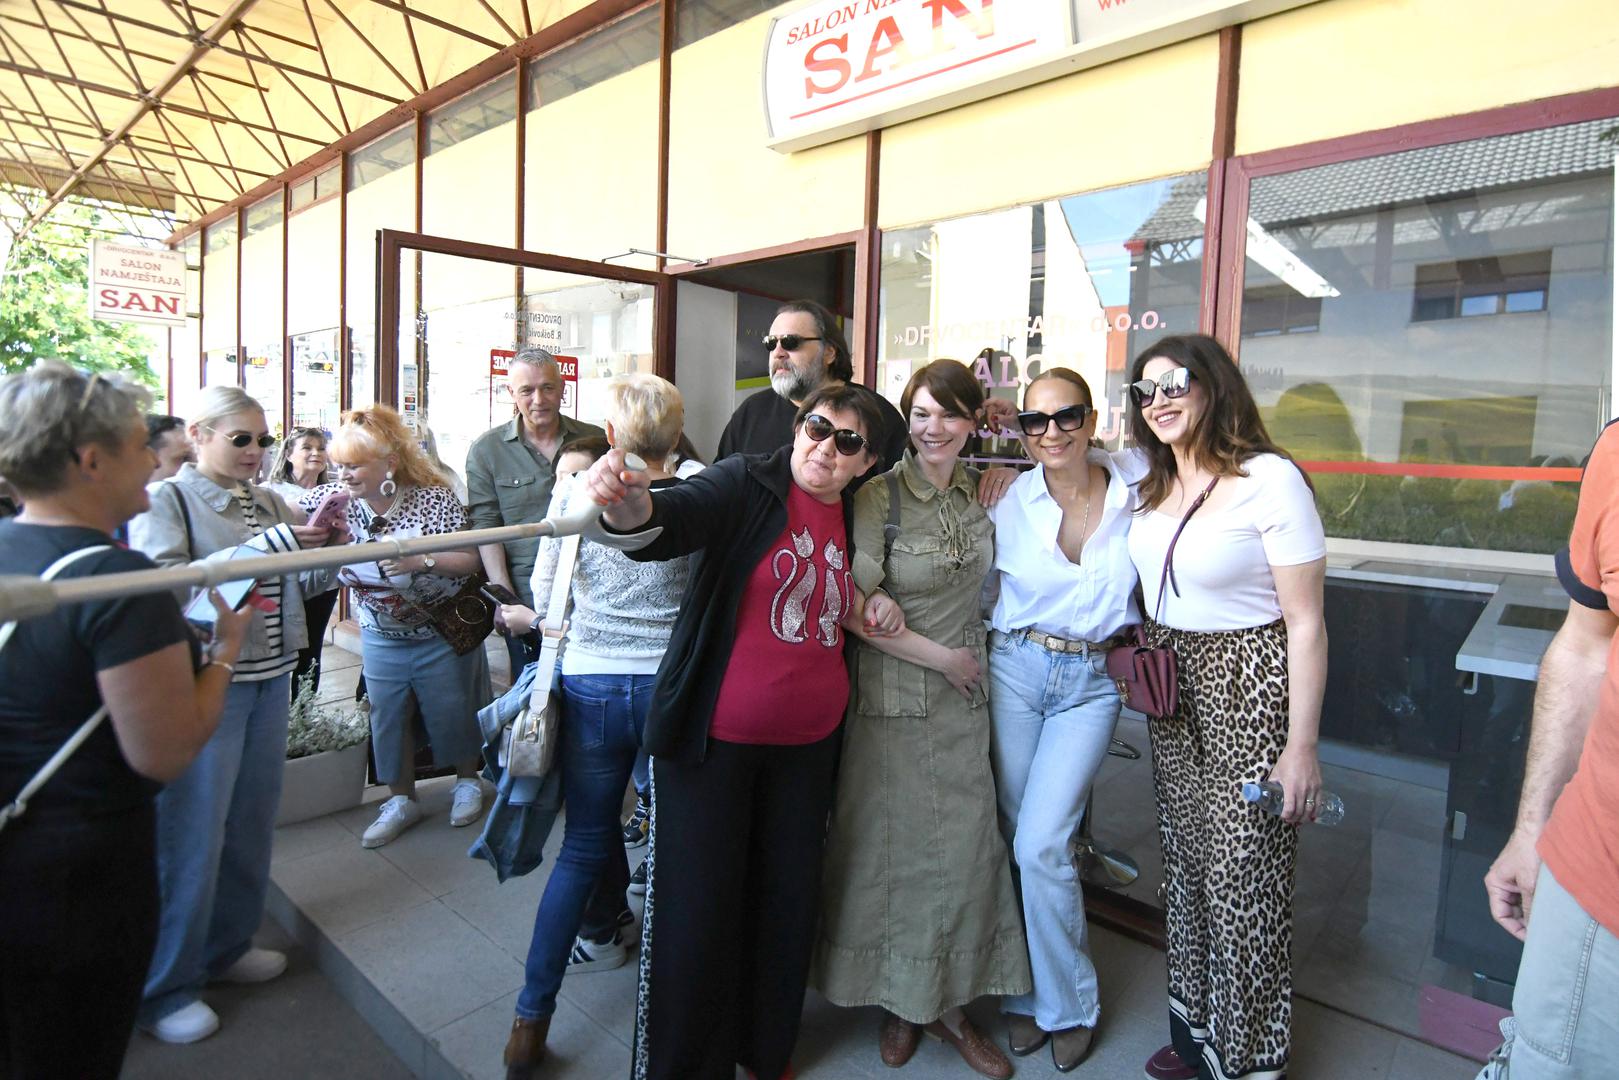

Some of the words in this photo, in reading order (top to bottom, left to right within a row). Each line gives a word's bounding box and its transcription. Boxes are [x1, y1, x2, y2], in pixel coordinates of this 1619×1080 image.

[786, 2, 859, 46] SALON
[803, 0, 996, 100] SAN
[99, 267, 182, 287] NAMJEŠTAJA
[120, 258, 162, 272] SALON
[100, 288, 181, 315] SAN
